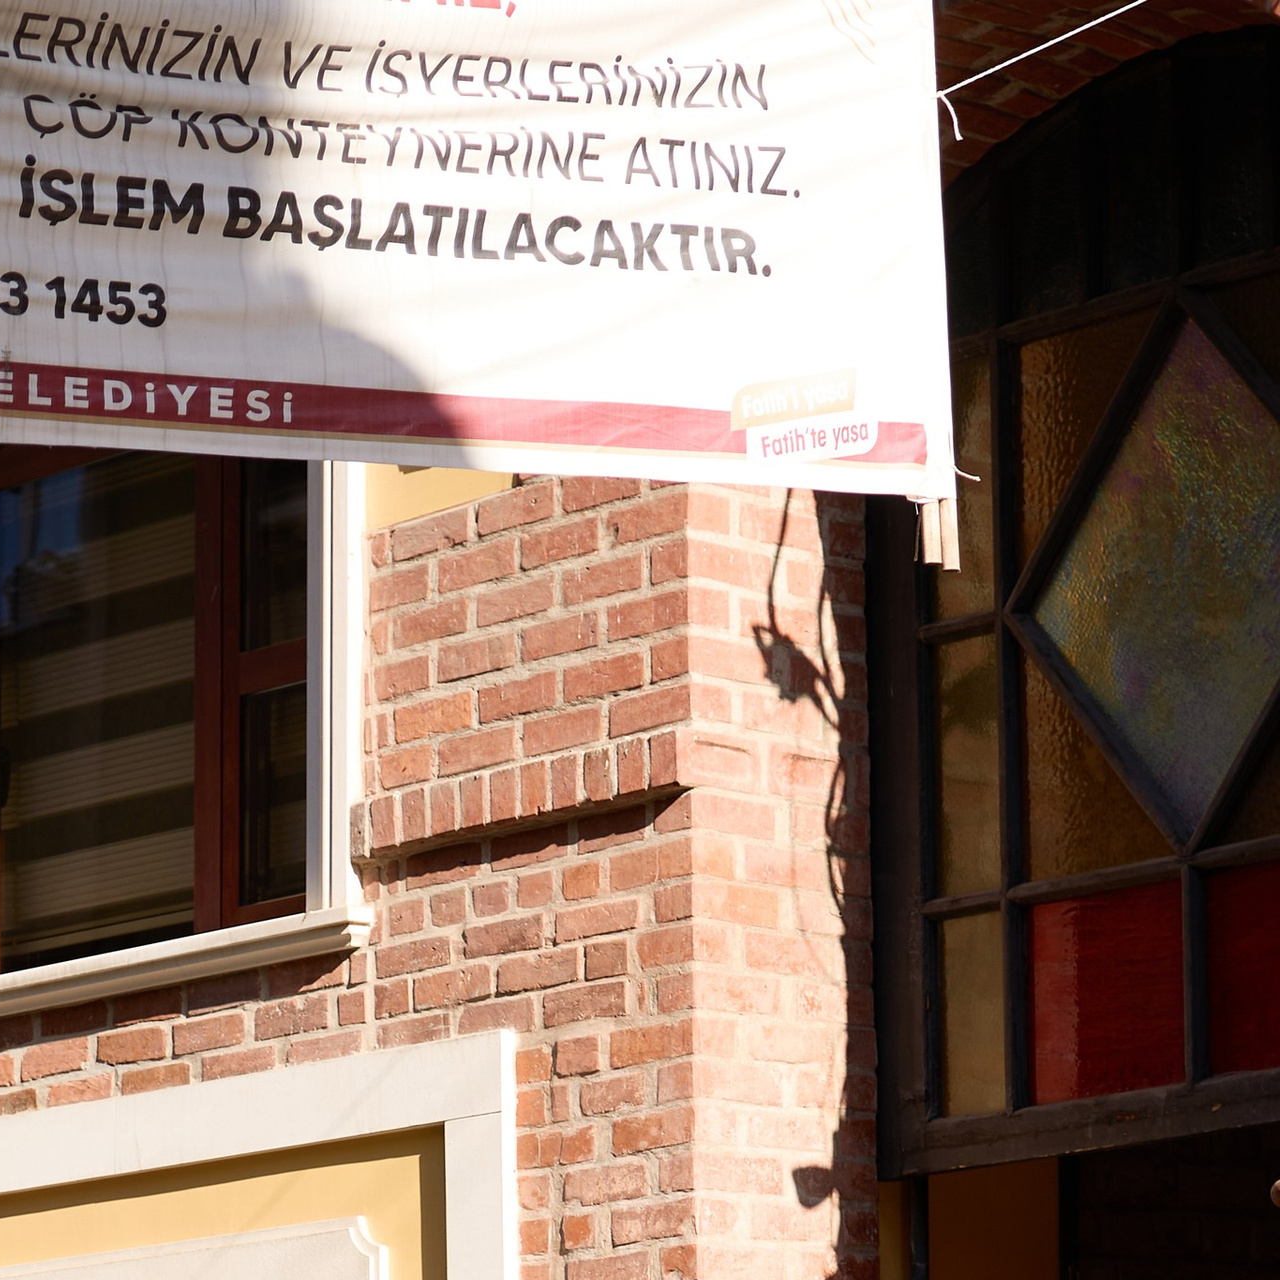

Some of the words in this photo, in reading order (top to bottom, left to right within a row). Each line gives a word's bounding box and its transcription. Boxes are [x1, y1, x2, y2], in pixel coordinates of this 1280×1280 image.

[283, 40, 352, 93] VE
[22, 91, 153, 139] ÇÖP
[624, 136, 801, 199] ATINIZ.
[18, 153, 205, 235] İŞLEM
[221, 184, 773, 278] BAŞLATILACAKTIR.
[44, 274, 169, 329] 1453
[832, 422, 869, 451] yaşa
